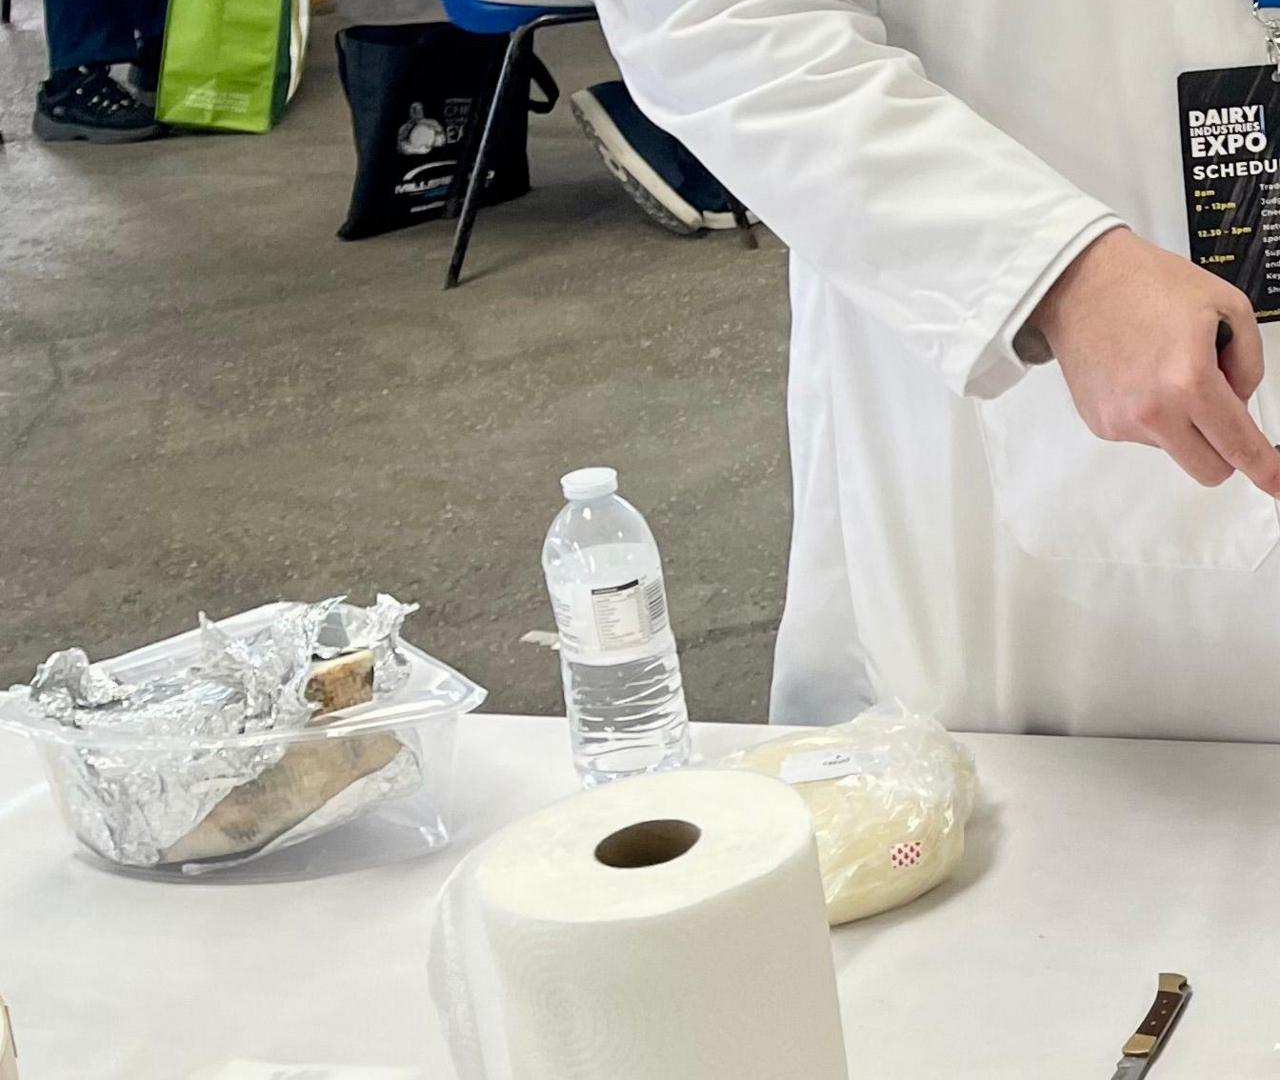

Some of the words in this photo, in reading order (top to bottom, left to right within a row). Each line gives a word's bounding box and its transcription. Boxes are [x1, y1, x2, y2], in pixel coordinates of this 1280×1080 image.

[1188, 105, 1259, 128] DAIRY
[1189, 121, 1261, 137] INDUSTRIES
[1190, 131, 1268, 158] EXPO
